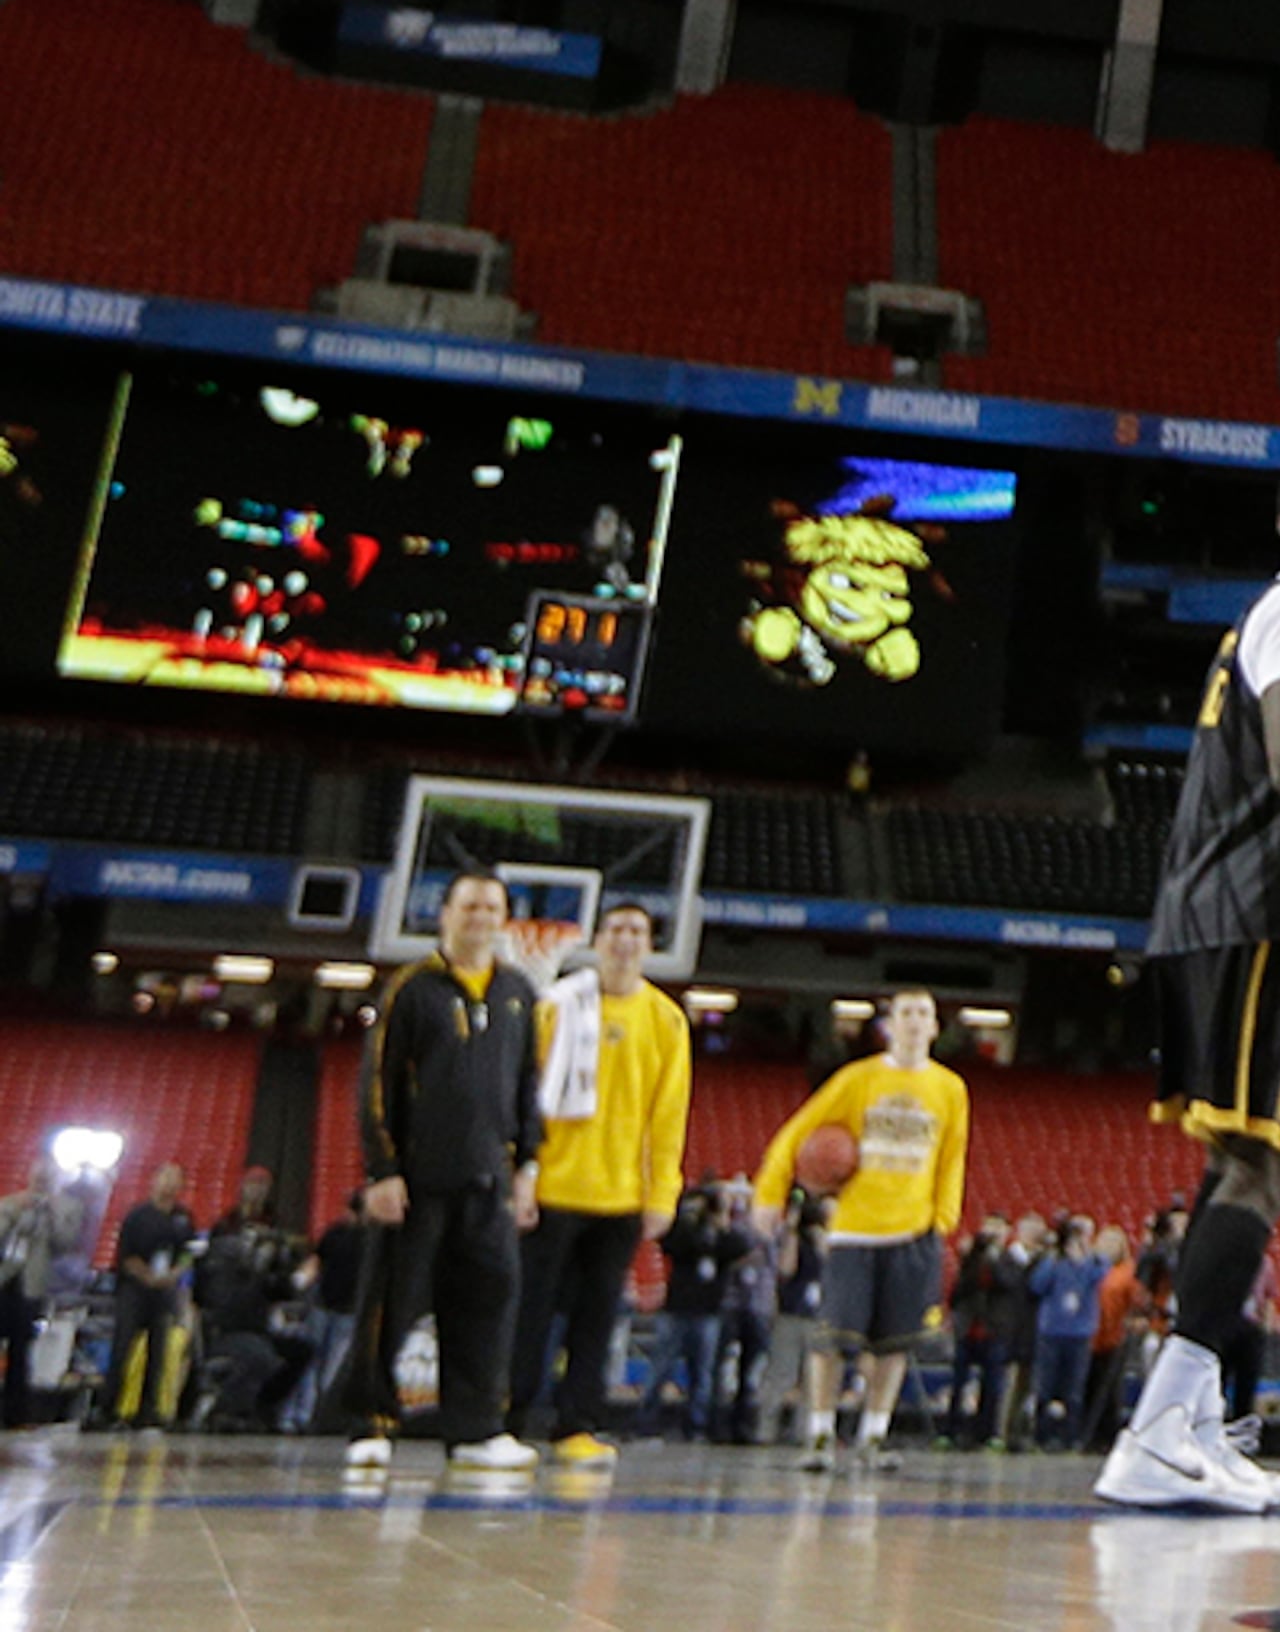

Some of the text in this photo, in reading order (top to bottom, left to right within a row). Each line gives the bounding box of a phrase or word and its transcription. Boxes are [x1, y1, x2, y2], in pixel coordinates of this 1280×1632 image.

[68, 286, 146, 330] STATE
[866, 387, 981, 428] MICHIGAN
[1160, 418, 1271, 460] SYRACUSE
